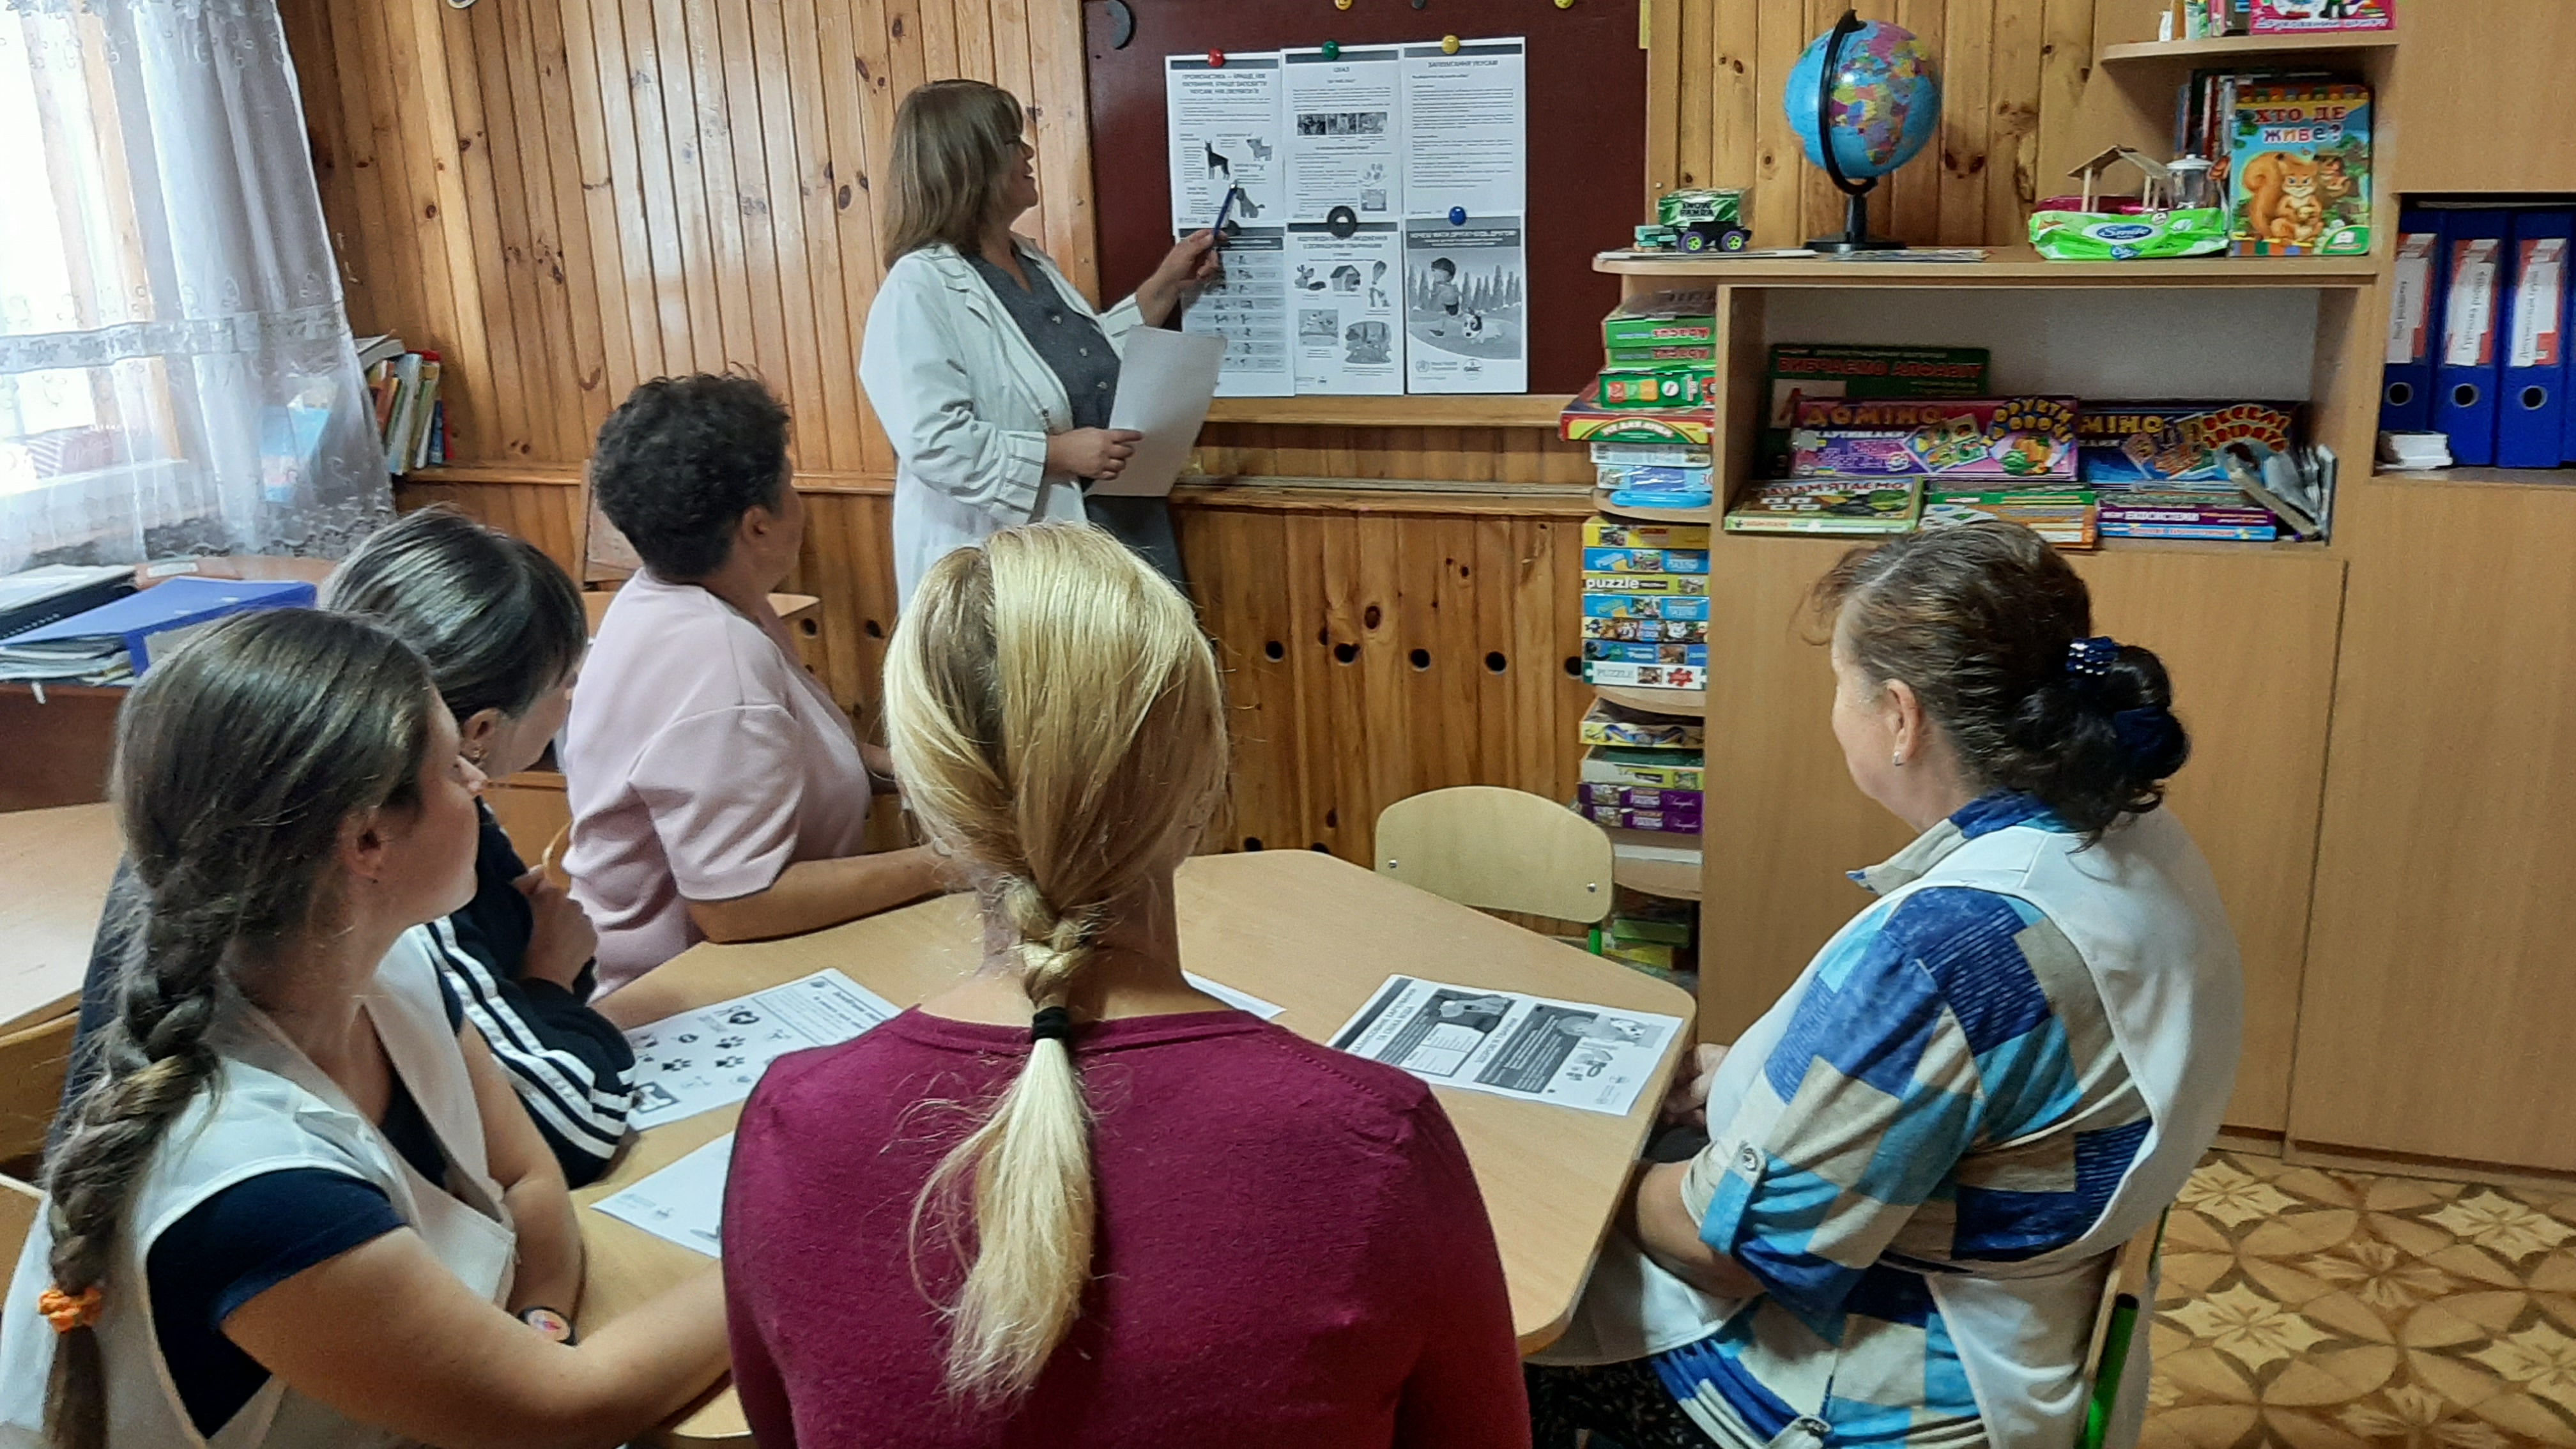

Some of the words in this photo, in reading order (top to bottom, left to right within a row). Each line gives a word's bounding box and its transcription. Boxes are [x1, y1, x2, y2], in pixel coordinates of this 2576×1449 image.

[2255, 108, 2303, 123] ХТО
[2313, 106, 2346, 121] ДЕ
[2099, 225, 2150, 237] Smile
[1804, 405, 1942, 426] ДОМІНО
[2079, 416, 2164, 433] МІНО
[1586, 577, 1639, 589] puzzle
